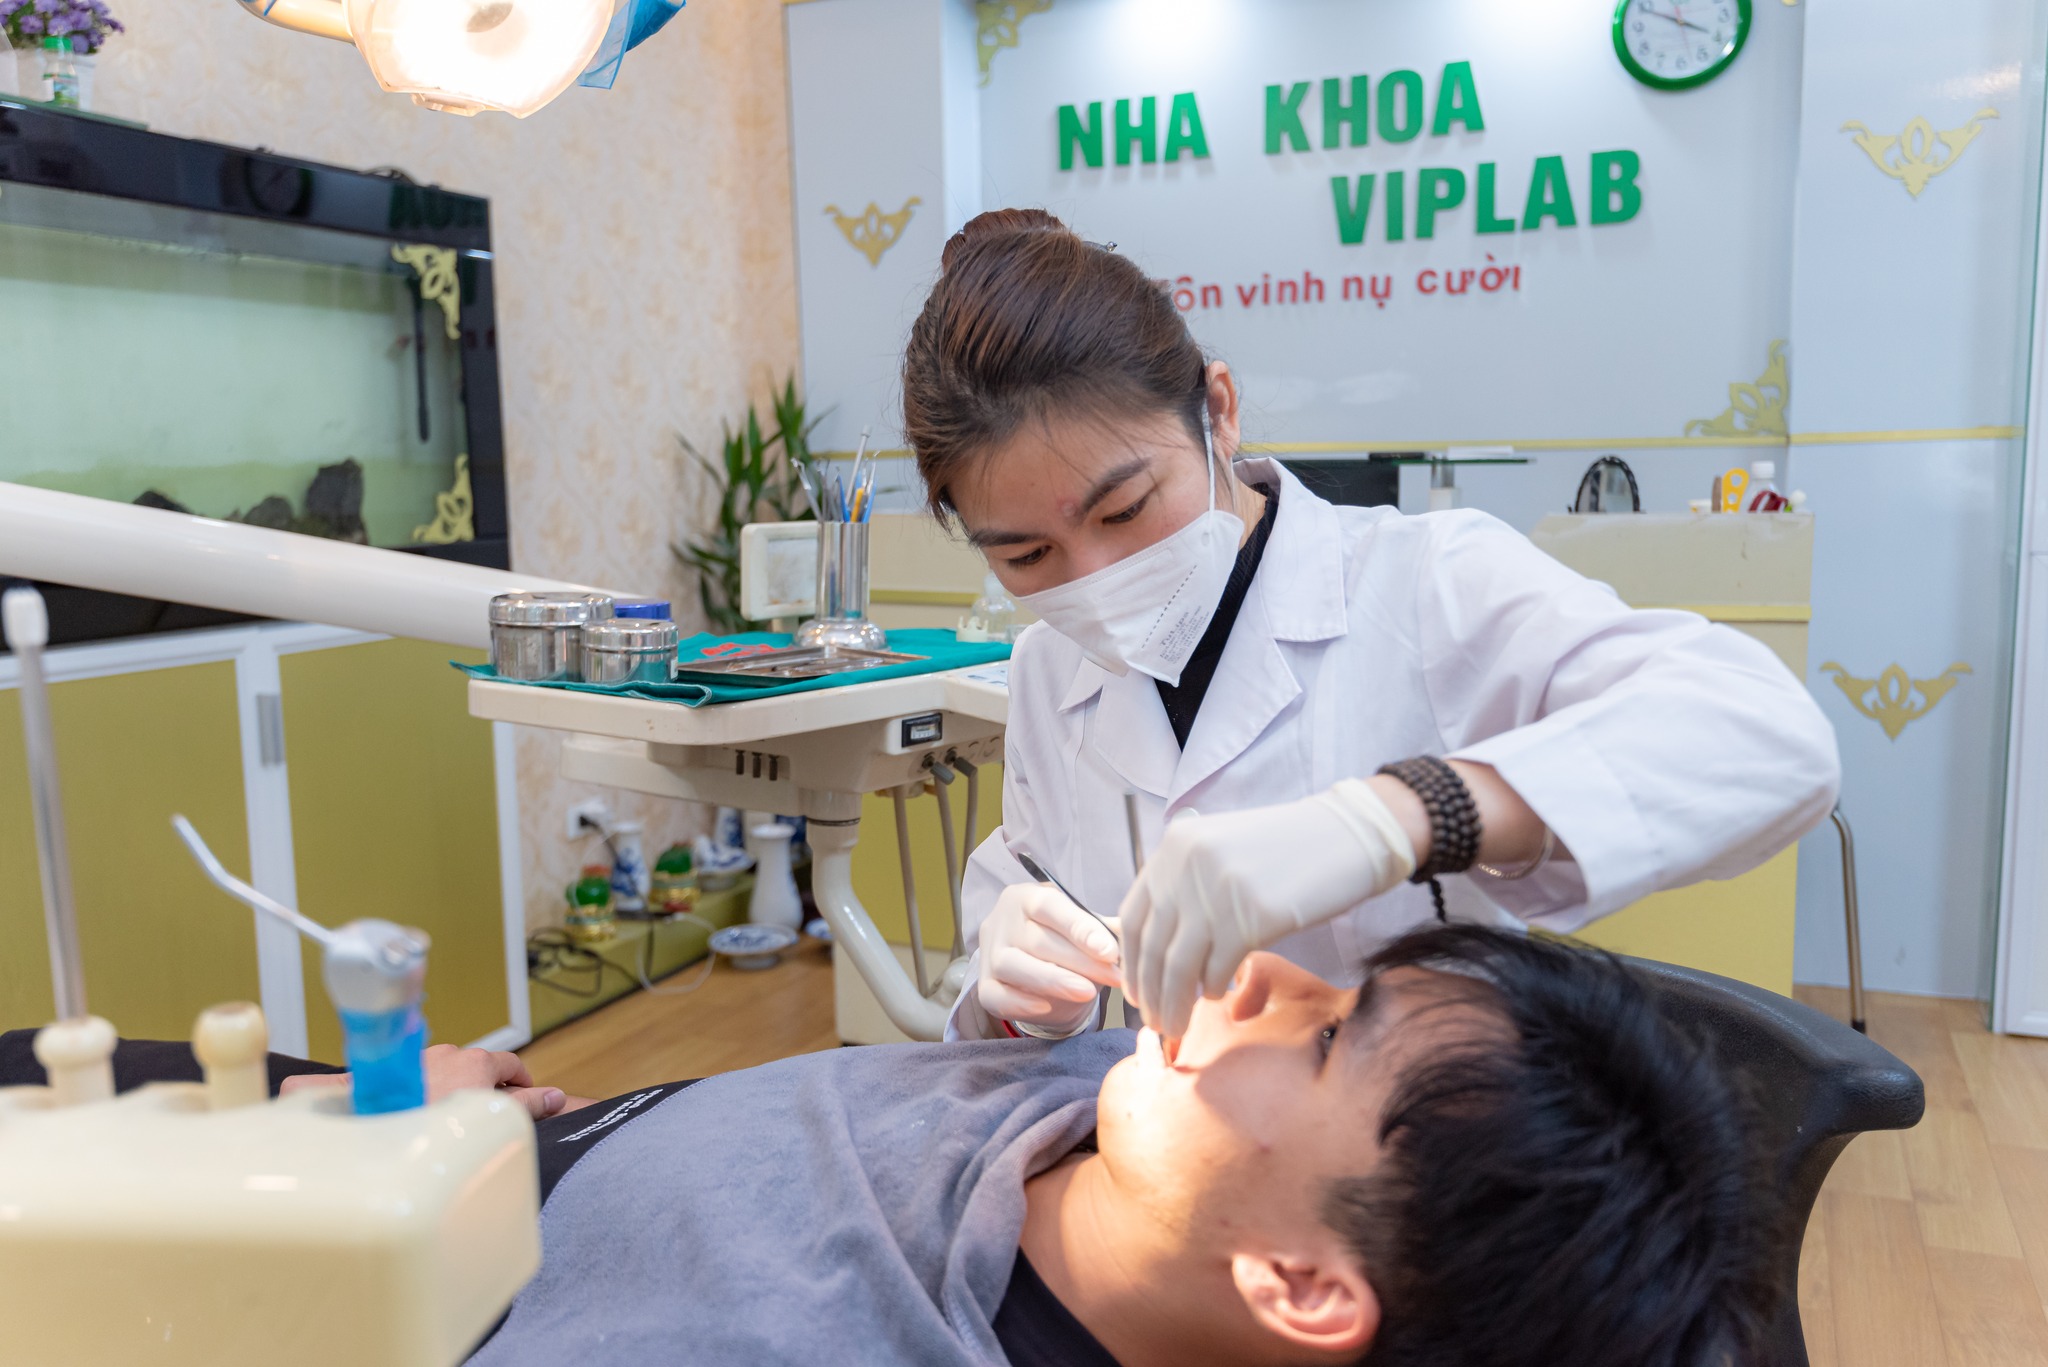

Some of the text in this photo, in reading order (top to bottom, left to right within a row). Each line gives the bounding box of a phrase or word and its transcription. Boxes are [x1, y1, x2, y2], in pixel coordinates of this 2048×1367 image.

[1056, 59, 1487, 172] NHA KHOA
[1327, 147, 1645, 246] VIPLAB
[1152, 252, 1522, 312] ôn vinh nụ cười
